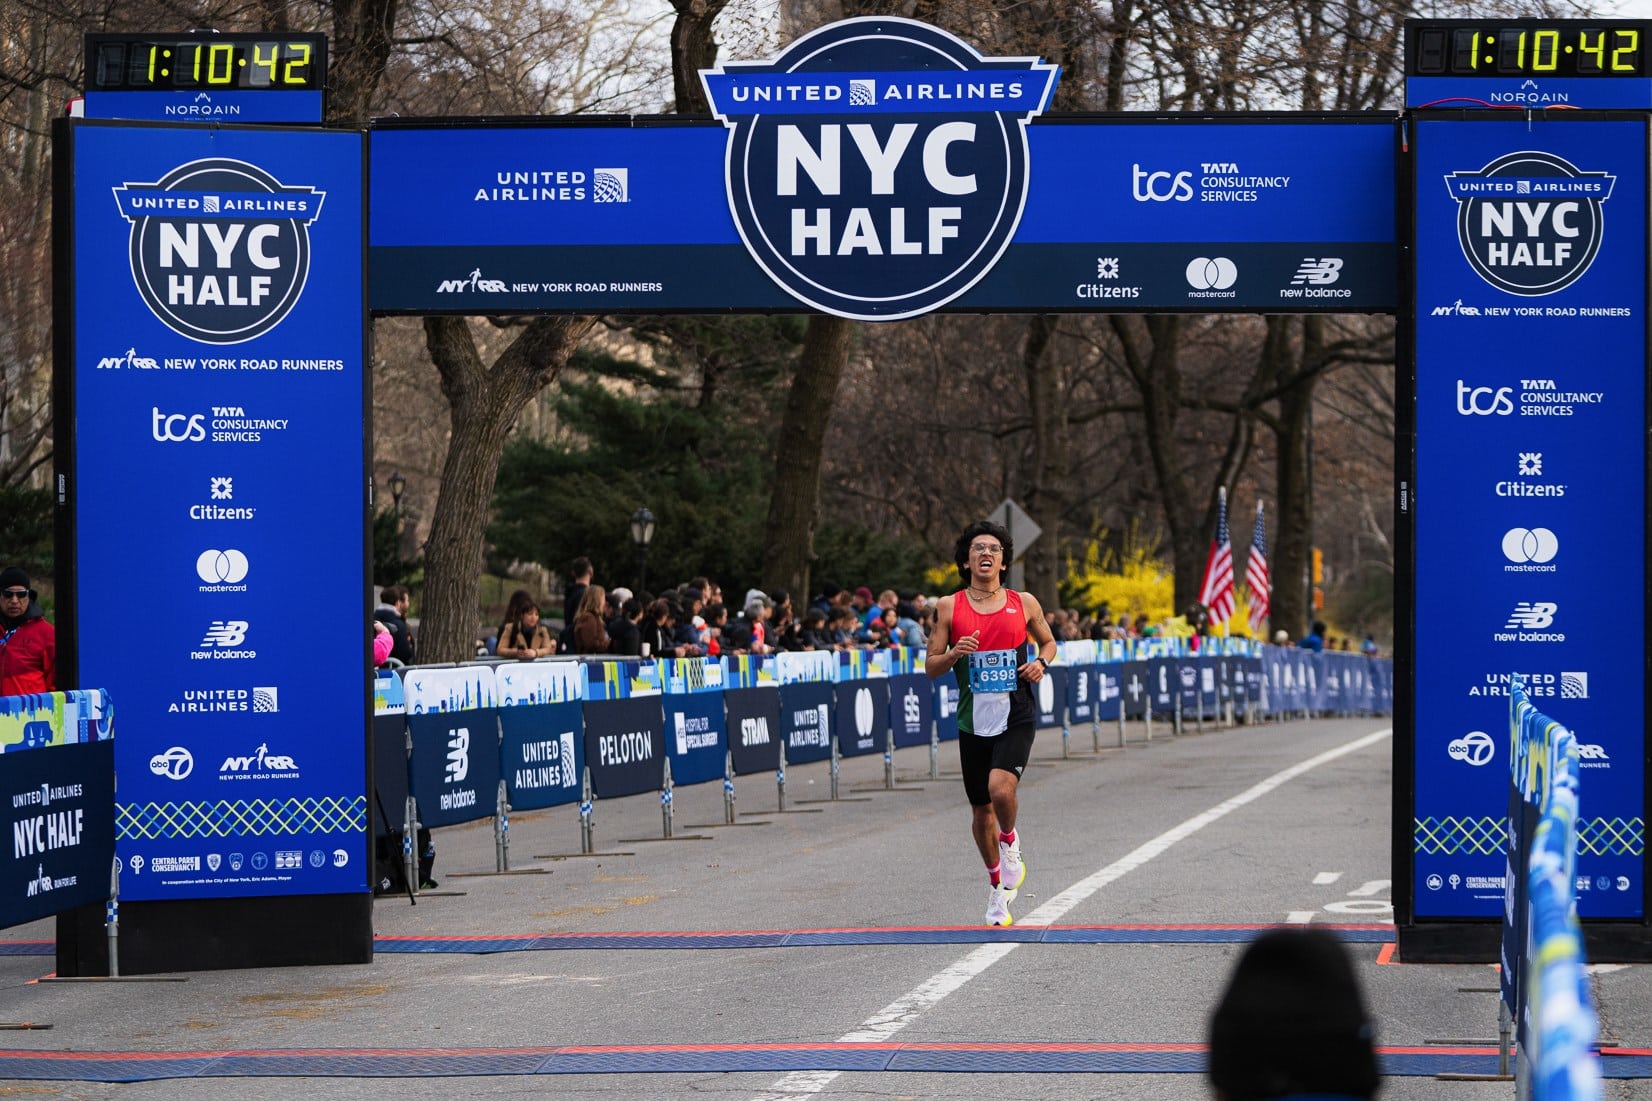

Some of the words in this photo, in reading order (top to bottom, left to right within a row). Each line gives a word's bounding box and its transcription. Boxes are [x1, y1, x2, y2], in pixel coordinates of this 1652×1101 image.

[733, 86, 841, 101] UNITED
[884, 83, 1022, 99] AIRLINES
[1490, 92, 1568, 103] NORQAIN
[165, 105, 240, 116] NORQAIN
[777, 122, 977, 195] NYC
[1201, 163, 1239, 173] TATA
[498, 172, 585, 184] UNITED
[1133, 164, 1193, 201] tcs
[1201, 177, 1289, 187] CONSULTANCY
[475, 188, 585, 200] AIRLINES
[1201, 191, 1257, 201] SERVICES
[132, 198, 199, 208] UNITED
[224, 200, 306, 211] AIRLINES
[1482, 202, 1579, 237] NYC
[792, 207, 961, 255] HALF
[160, 223, 280, 269] NYC
[1489, 243, 1571, 266] HALF
[169, 275, 271, 305] HALF
[513, 284, 539, 292] NEW
[542, 284, 572, 292] YORK
[576, 283, 607, 291] ROAD
[611, 283, 662, 291] RUNNERS
[1077, 284, 1141, 297] Citizens
[1305, 288, 1351, 297] balance
[1188, 289, 1236, 298] mastercard
[1514, 308, 1543, 316] YORK
[1546, 308, 1576, 316] ROAD
[1580, 308, 1630, 316] RUNNERS
[165, 359, 196, 369] NEW
[200, 359, 236, 369] YORK
[241, 360, 278, 369] ROAD
[282, 360, 343, 370] RUNNERS
[1521, 380, 1556, 389] TATA
[1457, 380, 1513, 415] tcs
[1521, 393, 1603, 402] CONSULTANCY
[212, 407, 244, 416] TATA
[1521, 406, 1573, 415] SERVICES
[153, 407, 205, 441] tcs
[212, 420, 288, 429] CONSULTANCY
[212, 432, 260, 441] SERVICES
[1496, 482, 1566, 496] Citizens
[190, 505, 255, 519] Citizens
[1504, 564, 1557, 572] mastercard
[199, 584, 247, 592] mastercard
[1519, 632, 1565, 641] balance
[214, 649, 256, 659] balance
[981, 669, 1015, 682] 6398
[1487, 674, 1555, 683] UNTED
[185, 690, 247, 700] UNITED
[1469, 687, 1555, 696] AIRLNES
[169, 702, 248, 712] AIRLINES
[794, 709, 818, 726] UNITED
[790, 728, 819, 748] AIRLINES
[522, 740, 559, 762] UNITED
[599, 731, 652, 766] PELOTON
[151, 760, 168, 770] abc
[516, 765, 560, 788] AIRLINES
[13, 791, 41, 808] UNITED
[50, 784, 82, 800] AIRLINES
[440, 793, 453, 810] new
[453, 789, 476, 808] balance
[14, 816, 45, 859] NYC
[47, 809, 83, 850] HALF
[152, 864, 195, 872] CONSERVANCY
